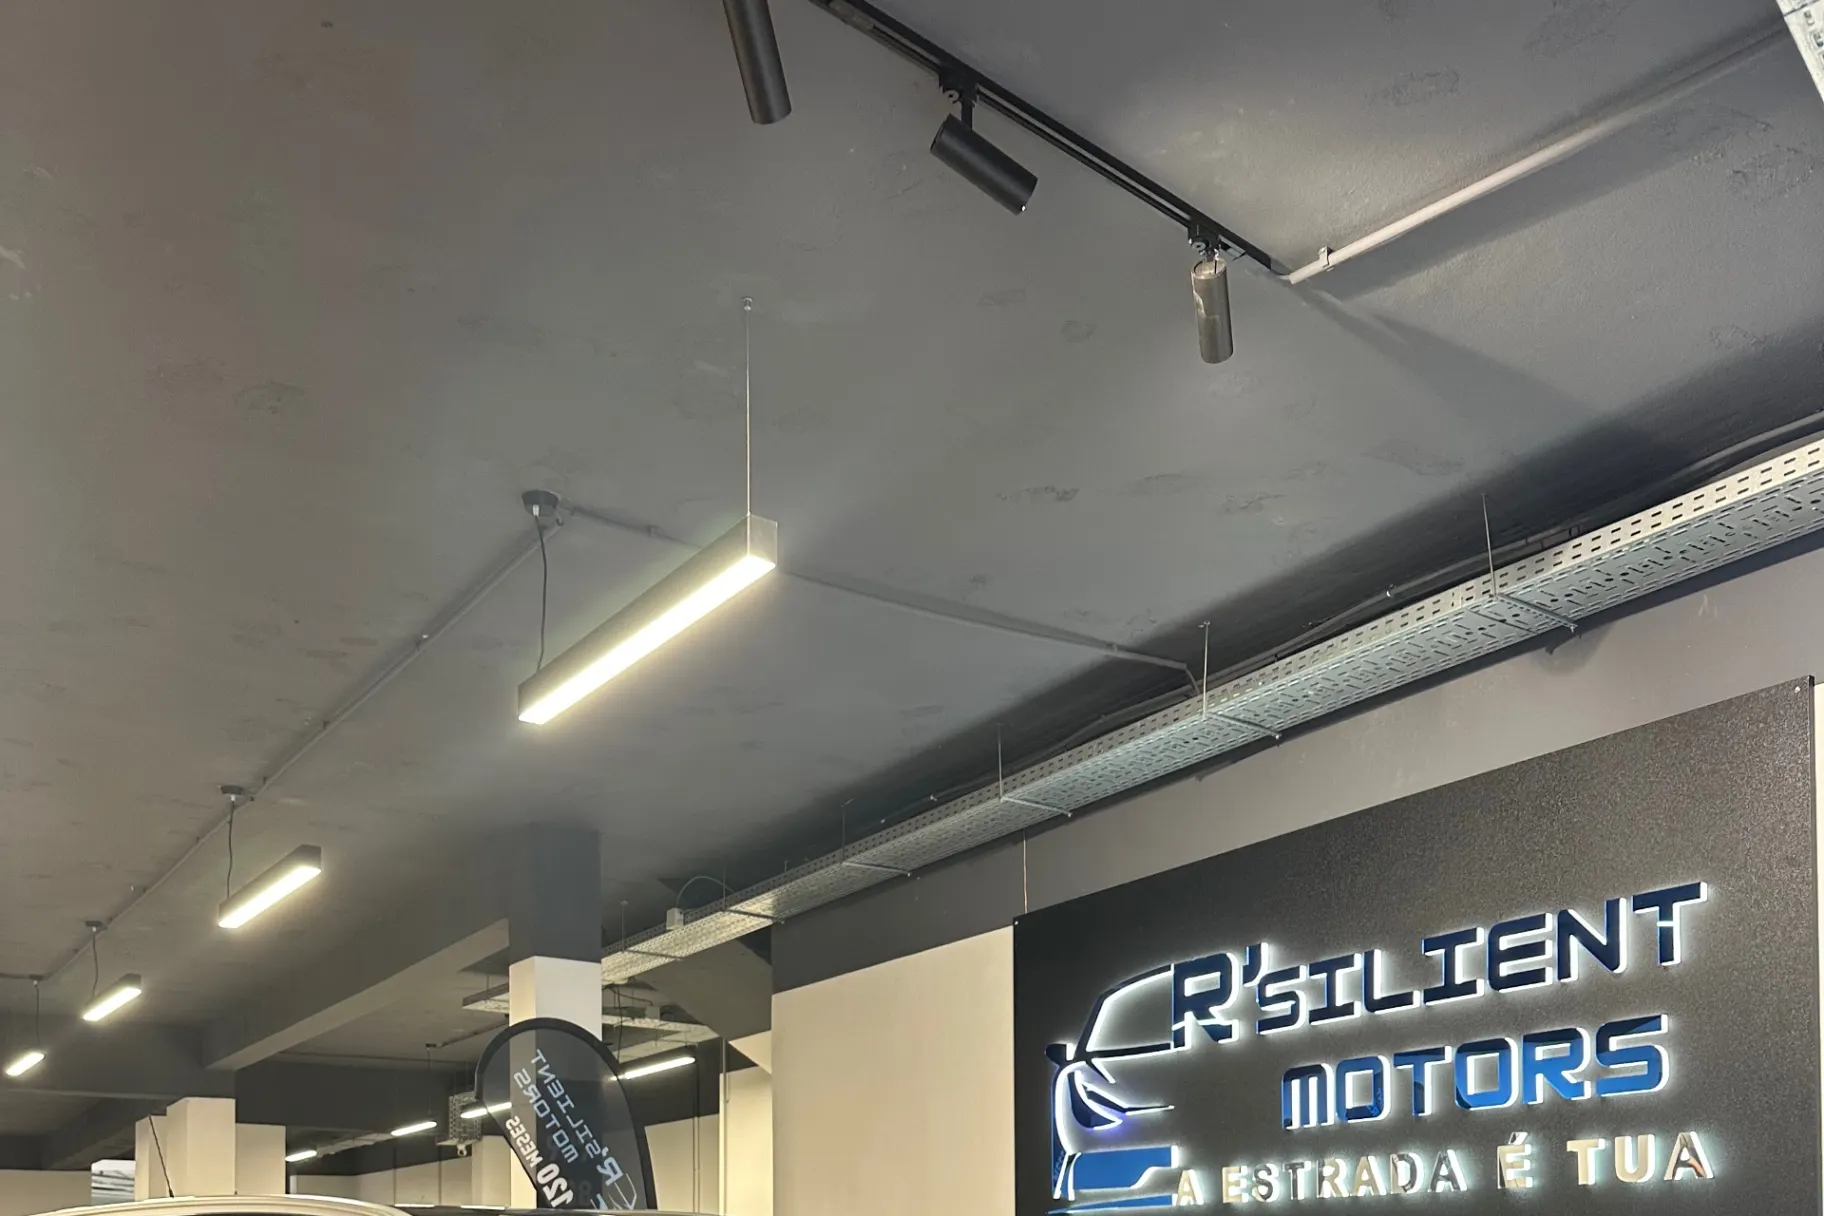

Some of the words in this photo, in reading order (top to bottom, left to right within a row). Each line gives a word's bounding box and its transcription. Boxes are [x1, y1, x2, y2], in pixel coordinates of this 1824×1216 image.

[1172, 882, 1707, 1050] R'SILIENT
[1281, 1014, 1669, 1129] MOTORS
[1174, 1170, 1204, 1206] A
[1222, 1149, 1467, 1205] ESTRADA
[1497, 1132, 1533, 1189] É
[1566, 1132, 1714, 1186] TUA
